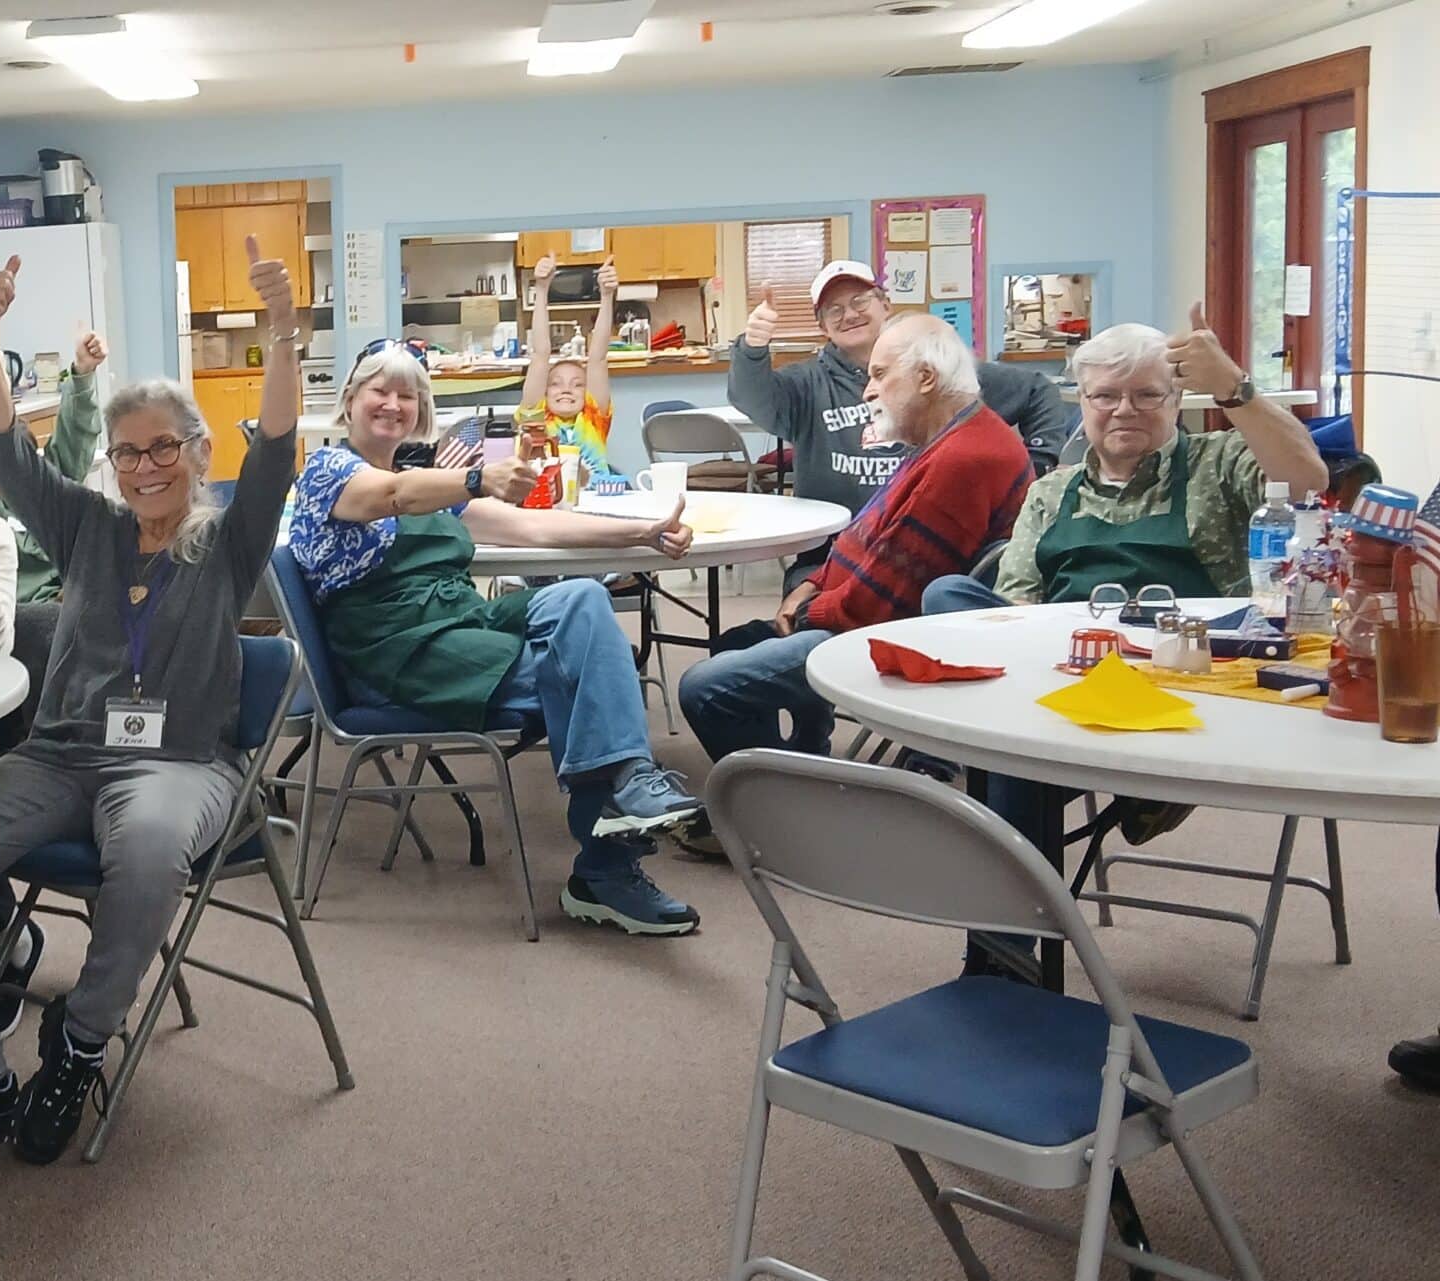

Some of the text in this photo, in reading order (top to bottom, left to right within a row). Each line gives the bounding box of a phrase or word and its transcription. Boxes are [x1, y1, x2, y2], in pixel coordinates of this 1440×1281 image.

[822, 402, 871, 432] SHIPP
[831, 451, 906, 476] UNIVER
[858, 475, 888, 486] ALU
